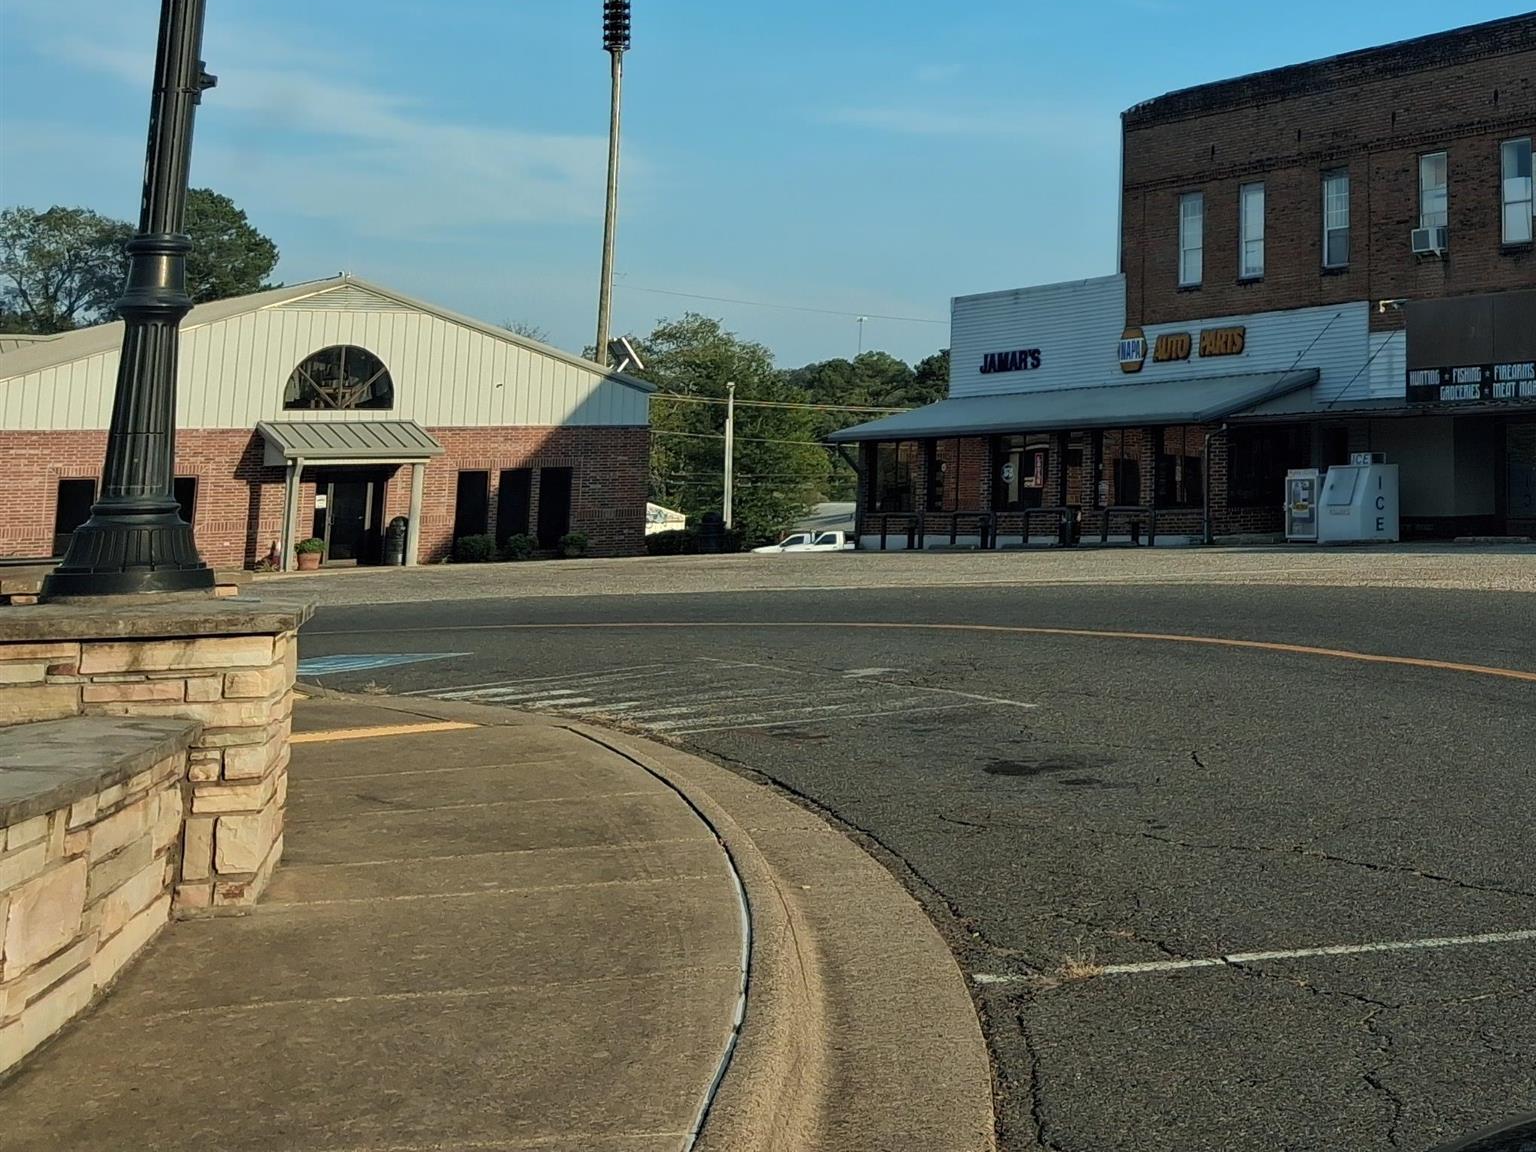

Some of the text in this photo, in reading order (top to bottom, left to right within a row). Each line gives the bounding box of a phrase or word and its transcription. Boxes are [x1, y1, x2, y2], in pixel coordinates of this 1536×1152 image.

[1120, 329, 1243, 361] NAPA AUTO PARTS
[980, 348, 1041, 374] JAMAR'S
[1409, 369, 1440, 386] HUNTING
[1452, 367, 1481, 383] FISHING
[1494, 363, 1535, 381] FIREARMS
[1440, 384, 1480, 401] GROCERIES
[1493, 382, 1516, 398] MEAT
[1352, 454, 1369, 464] ICE
[1375, 475, 1385, 532] ICE
